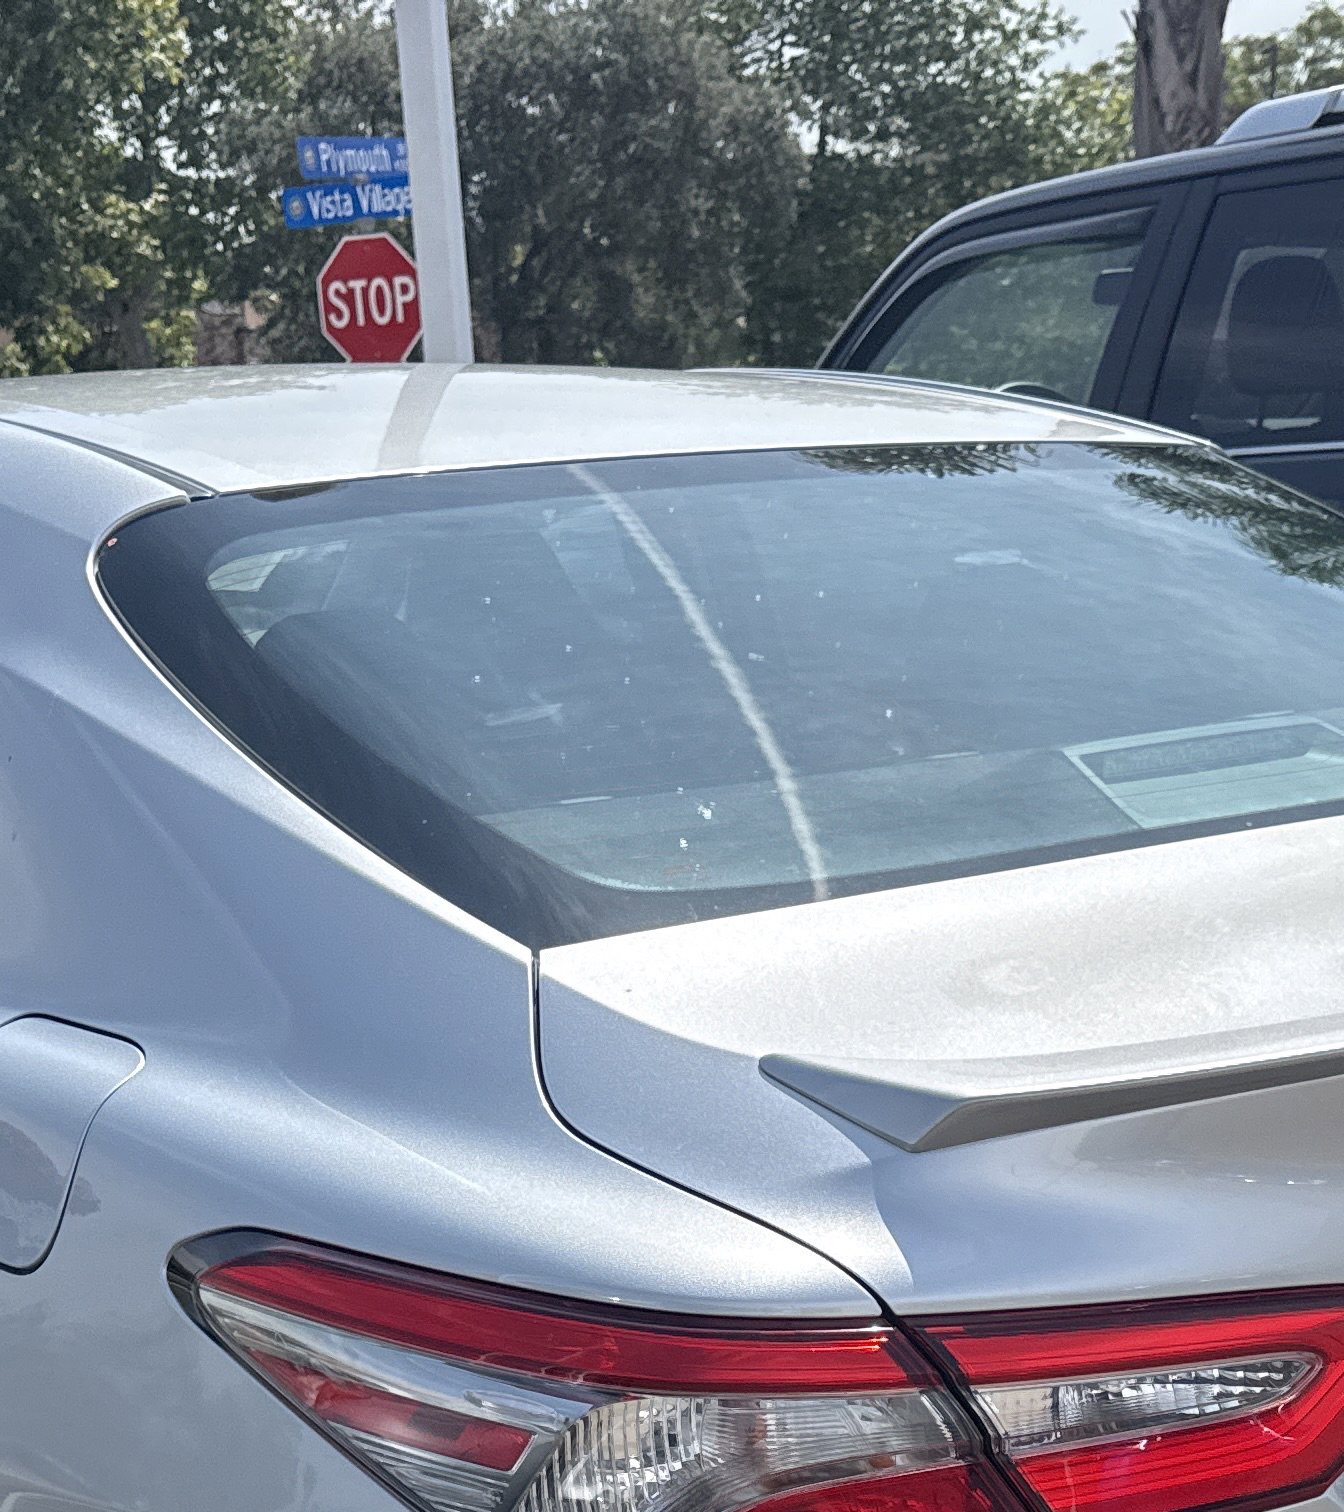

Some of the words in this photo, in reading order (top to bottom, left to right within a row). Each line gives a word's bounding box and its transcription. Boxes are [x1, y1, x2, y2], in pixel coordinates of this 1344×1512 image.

[318, 142, 392, 177] Plymouth
[306, 188, 354, 220] Vista
[326, 275, 416, 329] STOP
